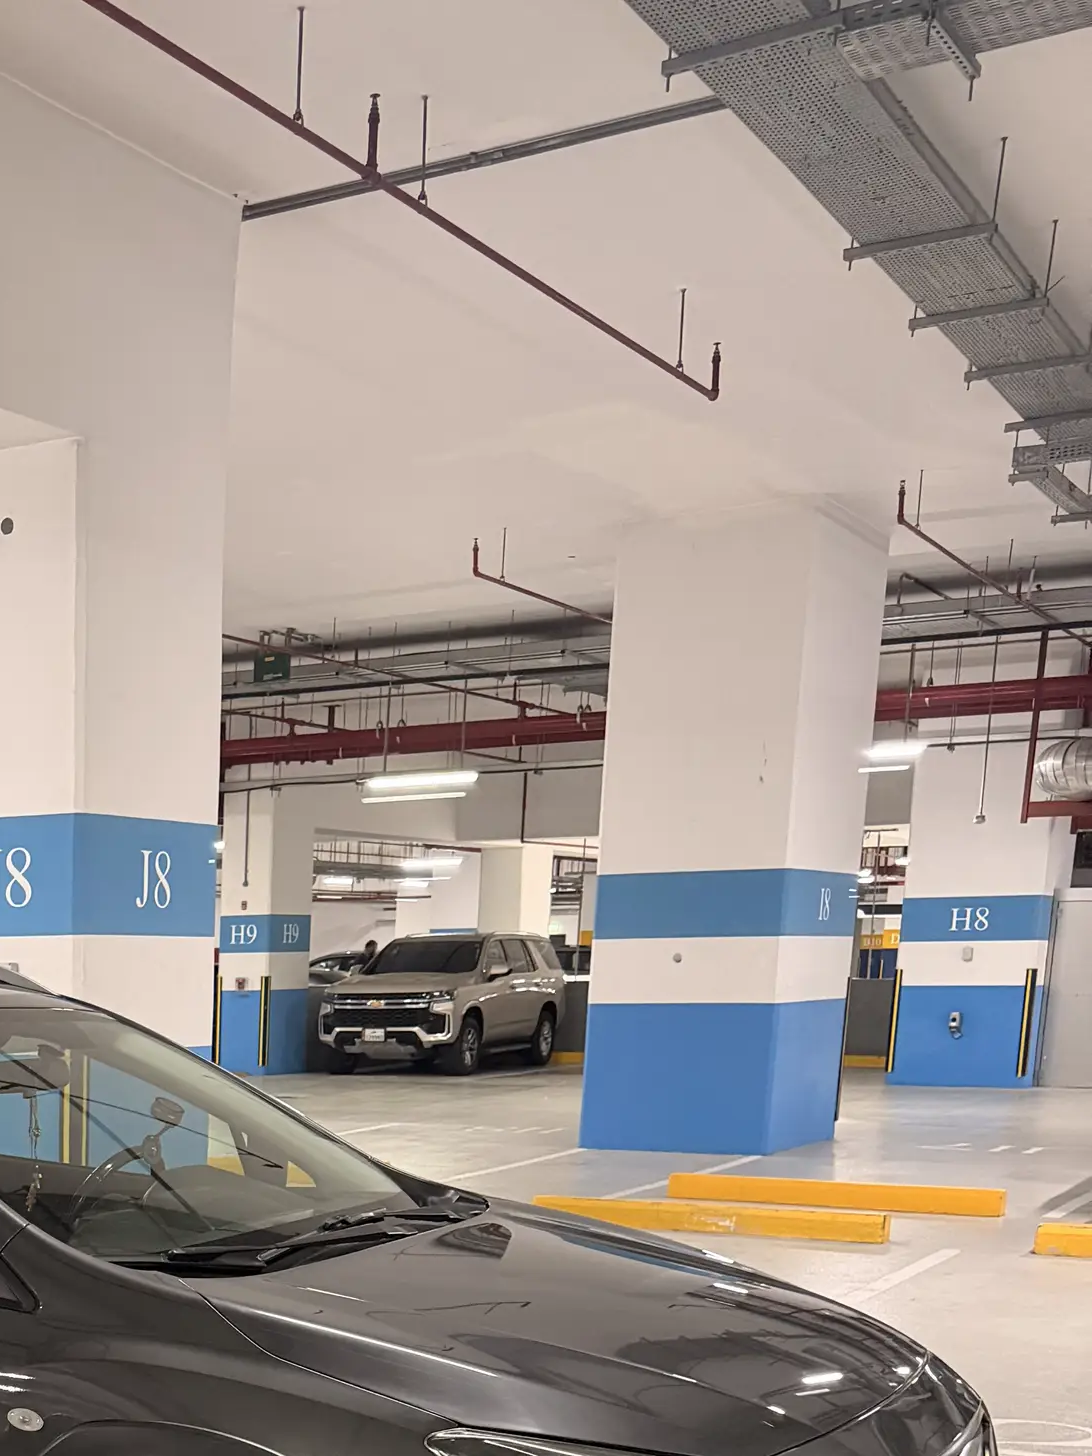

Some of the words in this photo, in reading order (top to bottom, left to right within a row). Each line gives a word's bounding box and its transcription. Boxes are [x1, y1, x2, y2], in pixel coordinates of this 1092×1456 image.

[135, 850, 171, 909] J8
[818, 887, 831, 921] I8
[949, 907, 989, 932] H8
[229, 924, 258, 945] H9
[282, 923, 299, 944] H9
